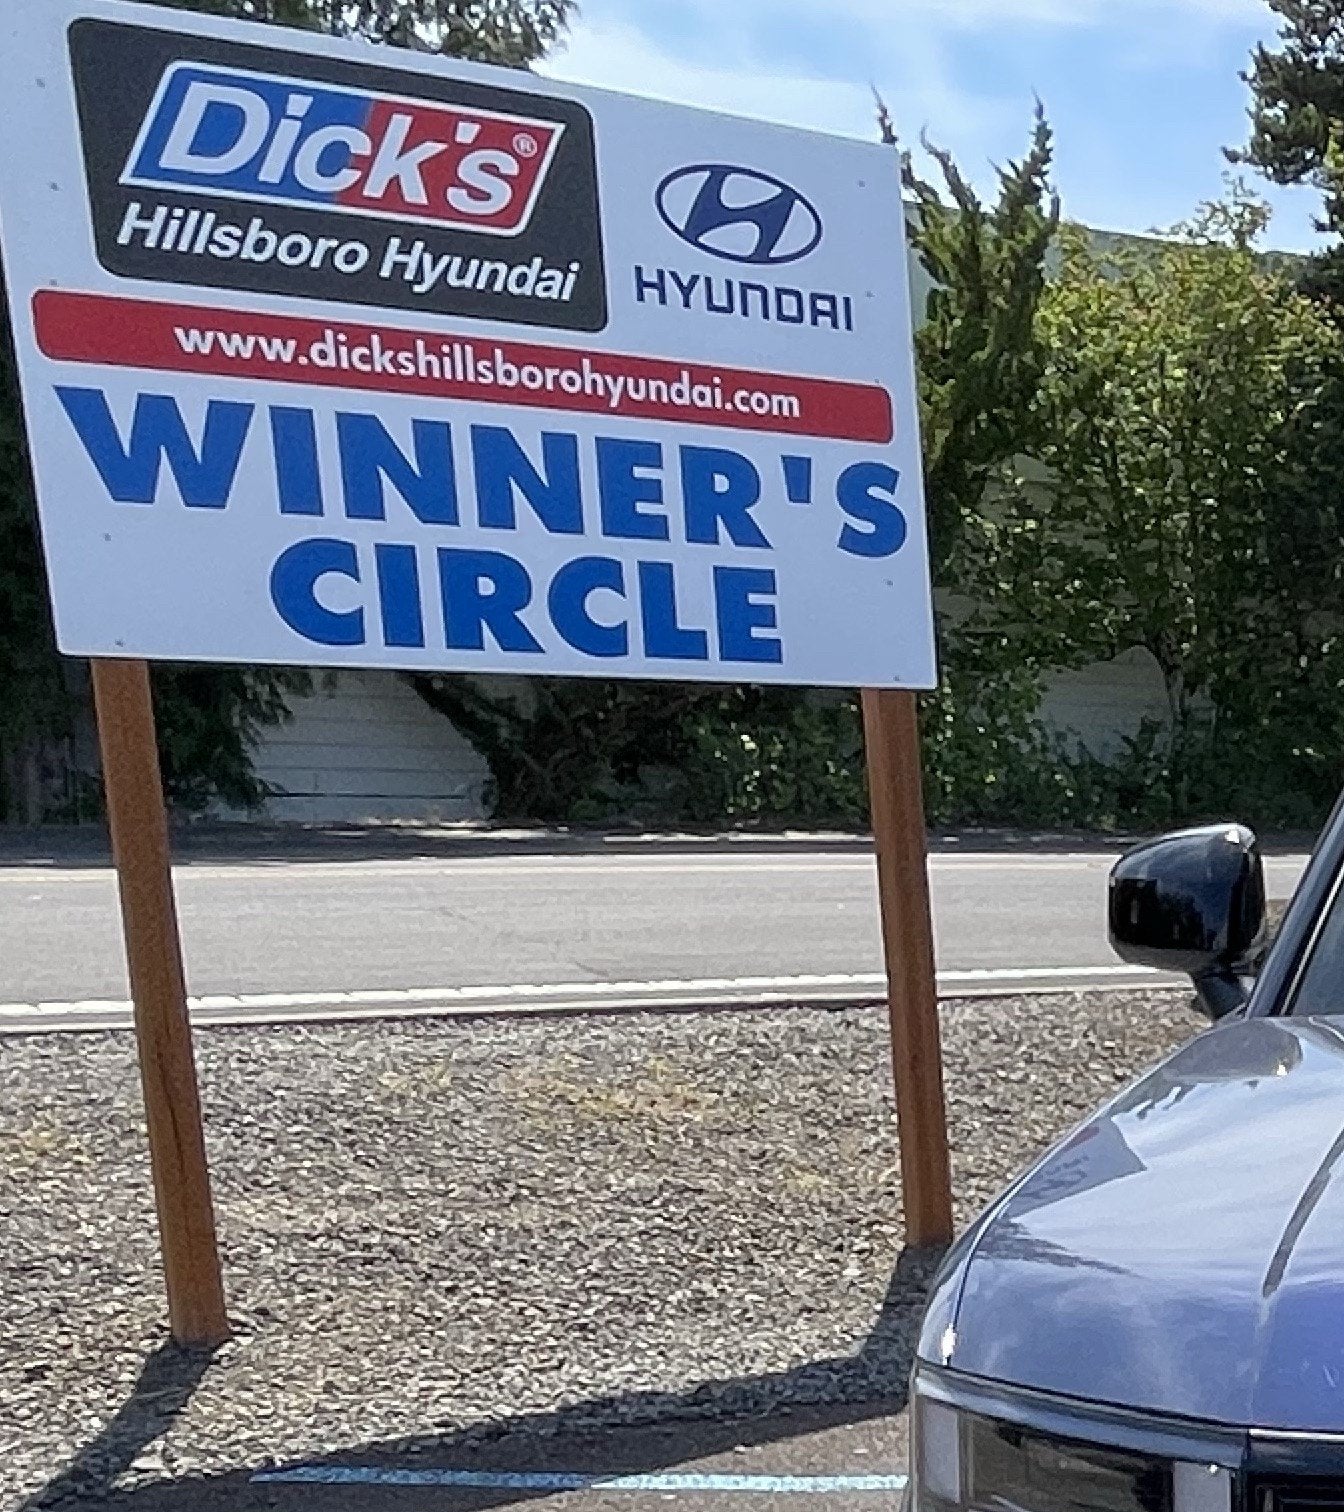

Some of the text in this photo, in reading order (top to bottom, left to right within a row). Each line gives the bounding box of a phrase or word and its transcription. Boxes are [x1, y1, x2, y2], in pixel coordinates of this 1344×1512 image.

[157, 80, 520, 217] Dick's
[116, 202, 580, 302] Hillsboro Hyundai
[634, 264, 853, 332] HYUNDAI
[173, 323, 801, 419] www.dickshillsborohyundai.com
[53, 384, 908, 559] WINNER'S
[269, 537, 784, 665] CIRCLE
